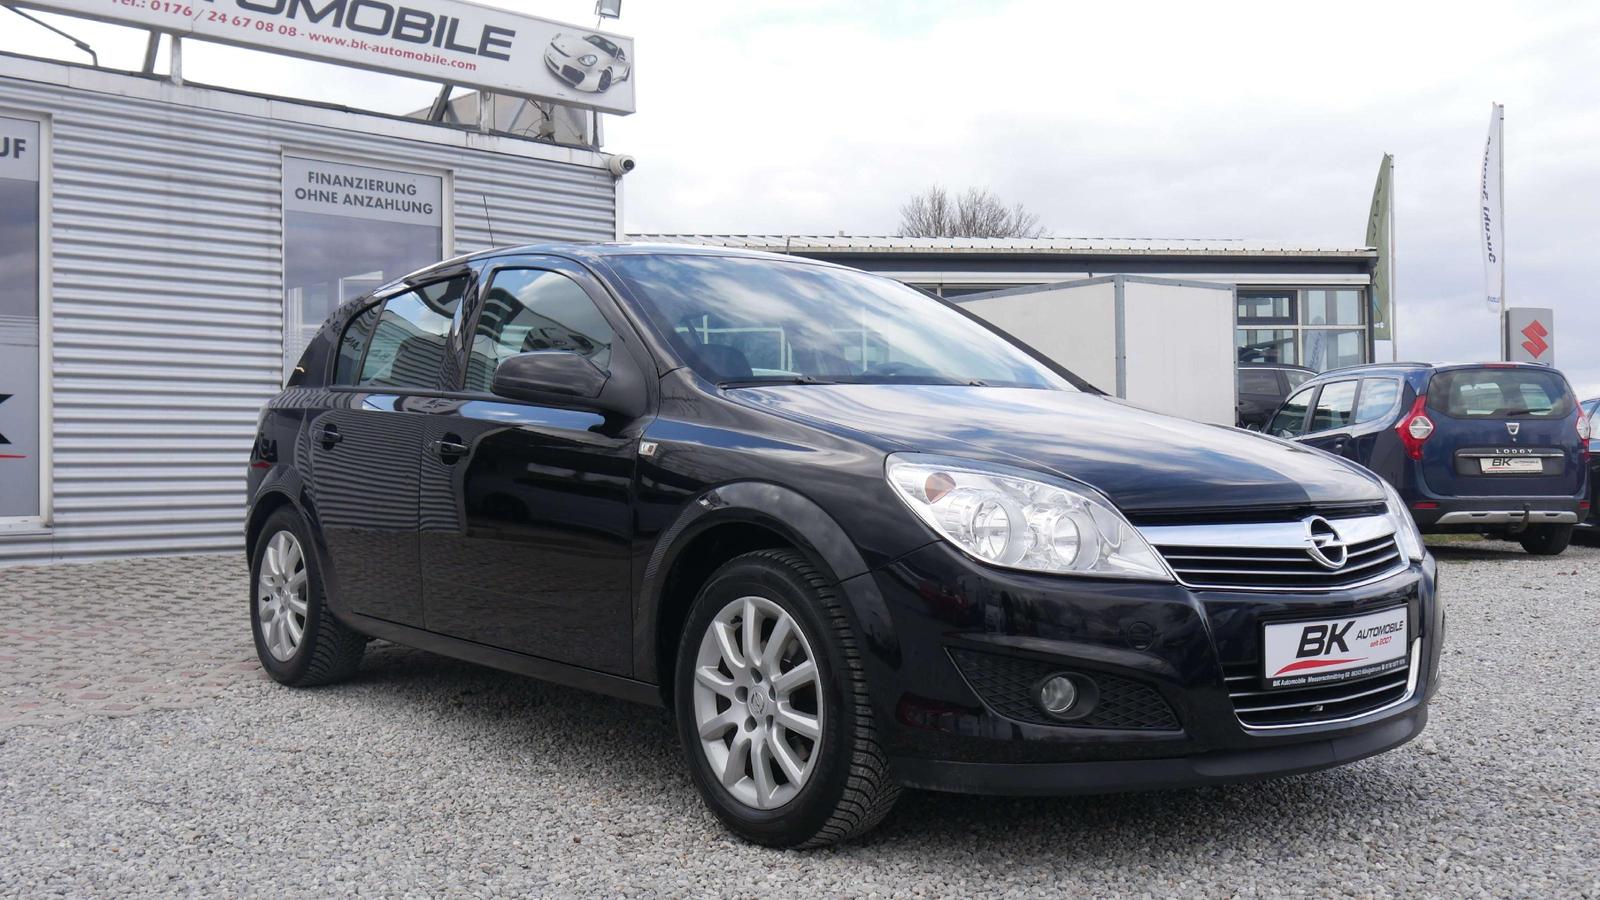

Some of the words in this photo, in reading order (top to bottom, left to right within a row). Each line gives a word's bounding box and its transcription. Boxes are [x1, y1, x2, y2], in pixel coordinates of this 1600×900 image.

[150, 0, 193, 17] 0176
[207, 10, 228, 24] 24
[231, 17, 252, 28] 67
[255, 20, 274, 33] 08
[278, 25, 297, 37] 08
[308, 32, 477, 71] www.bk-automobile.com
[203, 0, 516, 61] MOBILE
[308, 171, 417, 196] FINANZIERUNG
[295, 187, 338, 204] OHNE
[343, 193, 433, 215] ANZAHLUNG
[1492, 458, 1512, 466] BK
[1296, 620, 1356, 658] BK
[1356, 620, 1404, 640] AUTOMOBILE
[1281, 677, 1306, 686] Automobile
